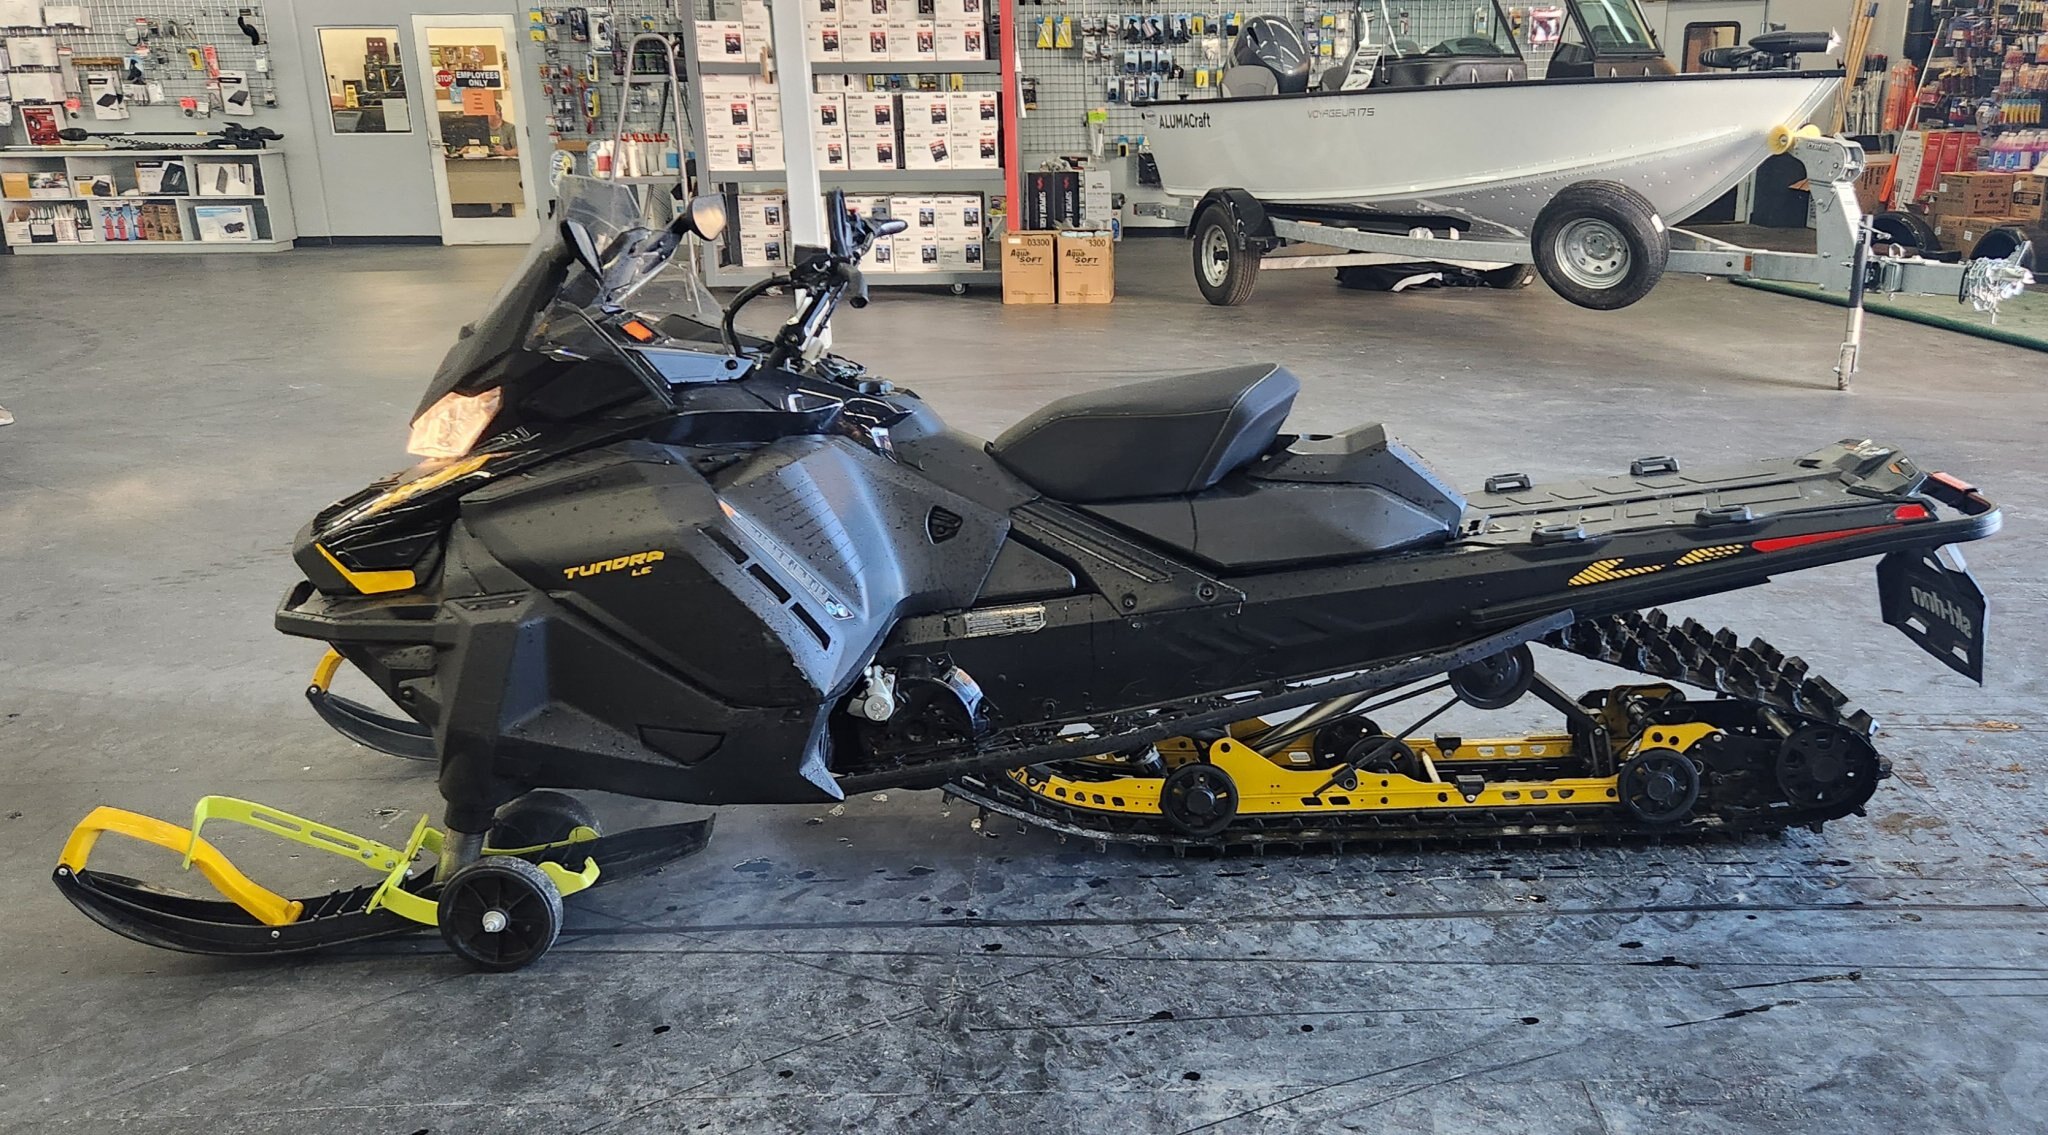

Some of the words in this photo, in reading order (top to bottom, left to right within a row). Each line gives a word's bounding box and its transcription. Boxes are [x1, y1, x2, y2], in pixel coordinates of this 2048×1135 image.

[456, 71, 499, 79] EMPLOYEES
[1307, 108, 1356, 119] VOYAGEUR
[1159, 111, 1211, 129] ALUMACraft
[1027, 238, 1050, 247] 03300
[563, 550, 665, 580] TUNDRA
[631, 566, 653, 577] LE
